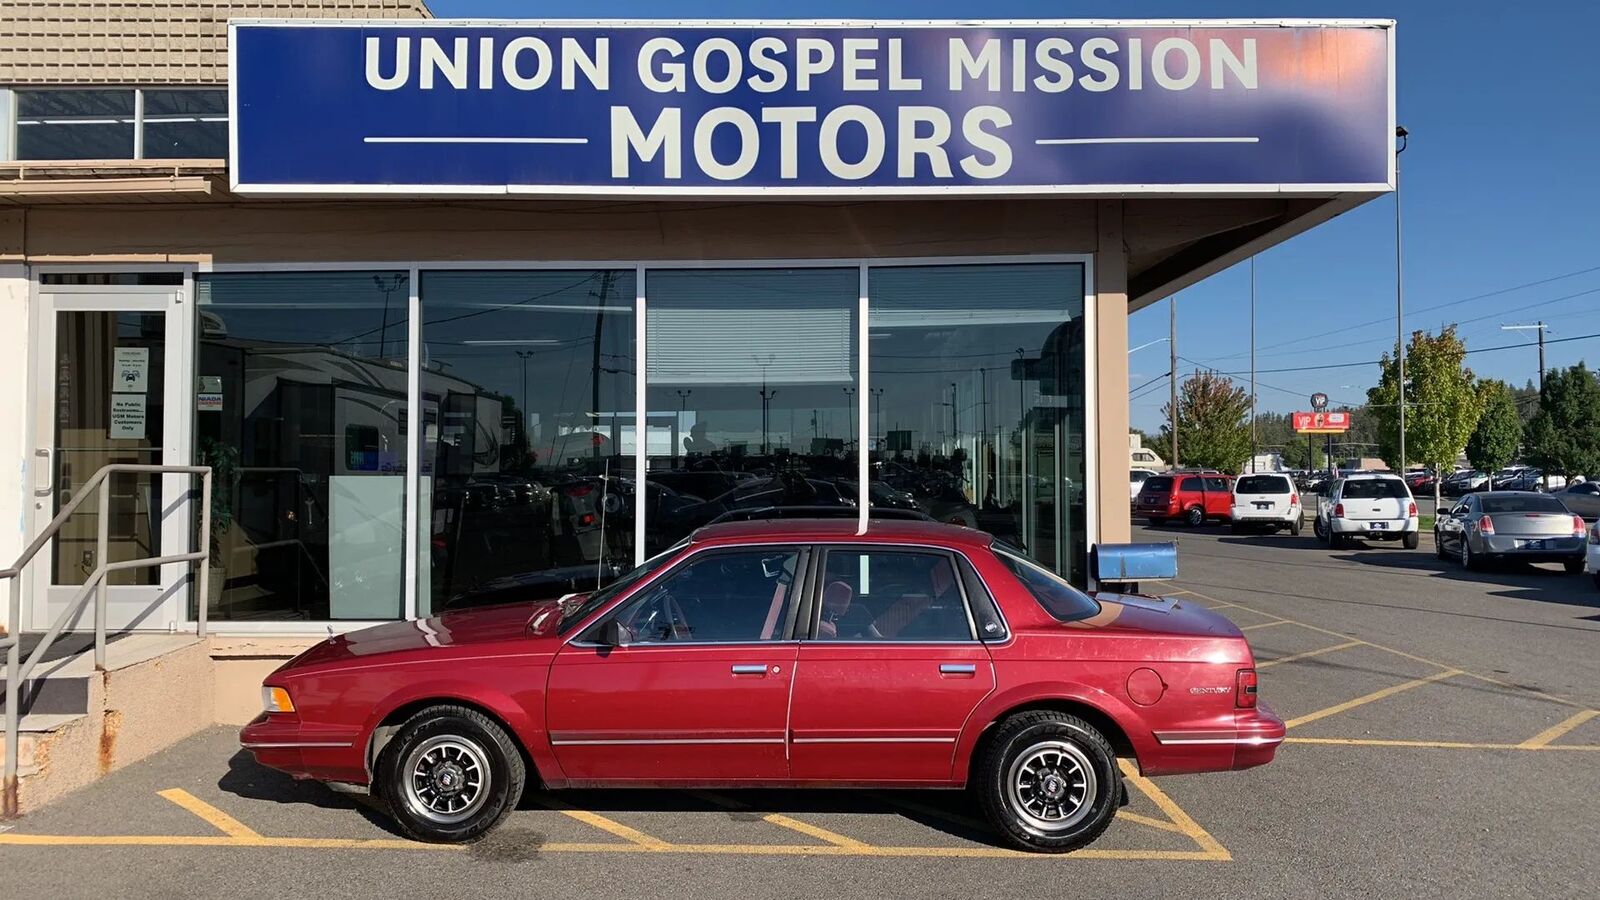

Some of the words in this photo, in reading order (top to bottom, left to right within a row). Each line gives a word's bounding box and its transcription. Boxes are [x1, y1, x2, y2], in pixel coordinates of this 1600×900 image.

[365, 37, 609, 91] UNION
[637, 37, 922, 94] GOSPEL
[948, 37, 1259, 93] MISSION
[610, 105, 1013, 181] MOTORS
[1298, 416, 1311, 427] VIP
[1189, 686, 1231, 694] CENTURY
